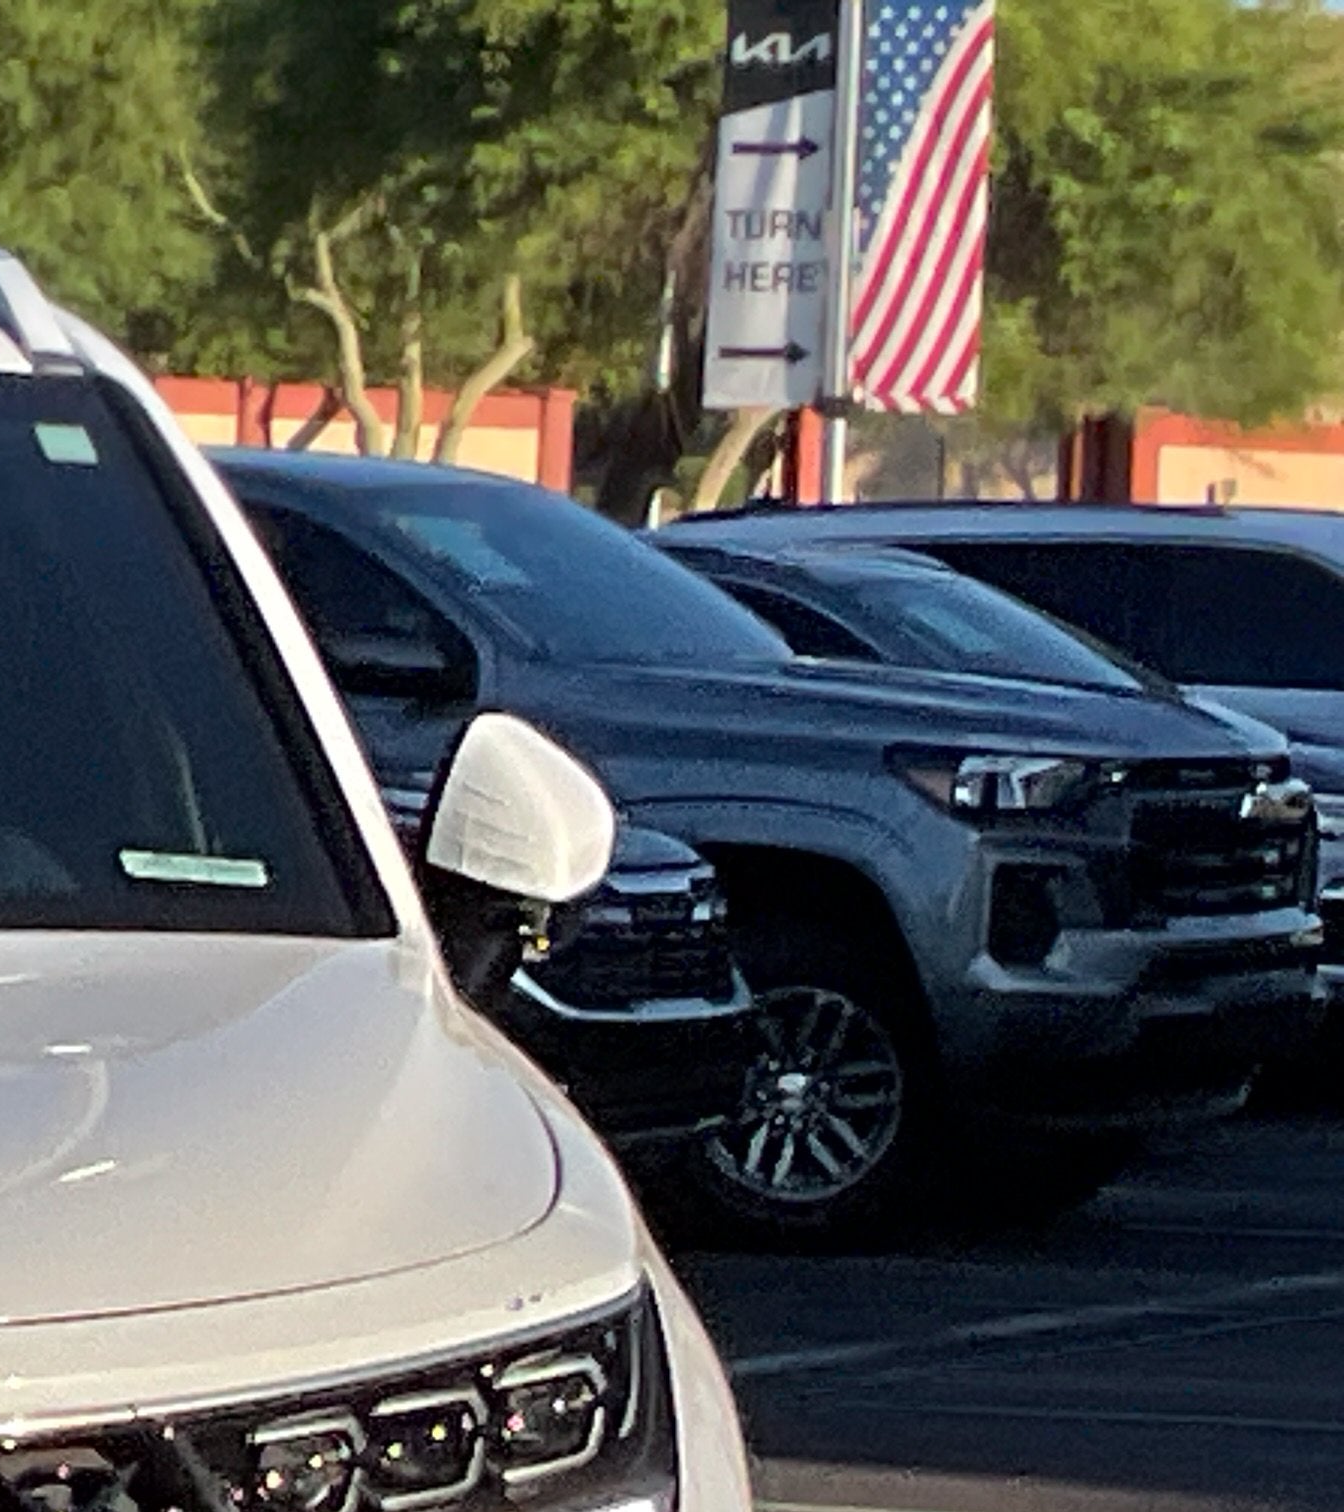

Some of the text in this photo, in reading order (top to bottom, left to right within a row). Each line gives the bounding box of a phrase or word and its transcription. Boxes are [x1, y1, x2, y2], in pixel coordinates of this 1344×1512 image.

[731, 31, 831, 64] KIA
[724, 209, 822, 240] TURN
[723, 260, 818, 292] HERE
